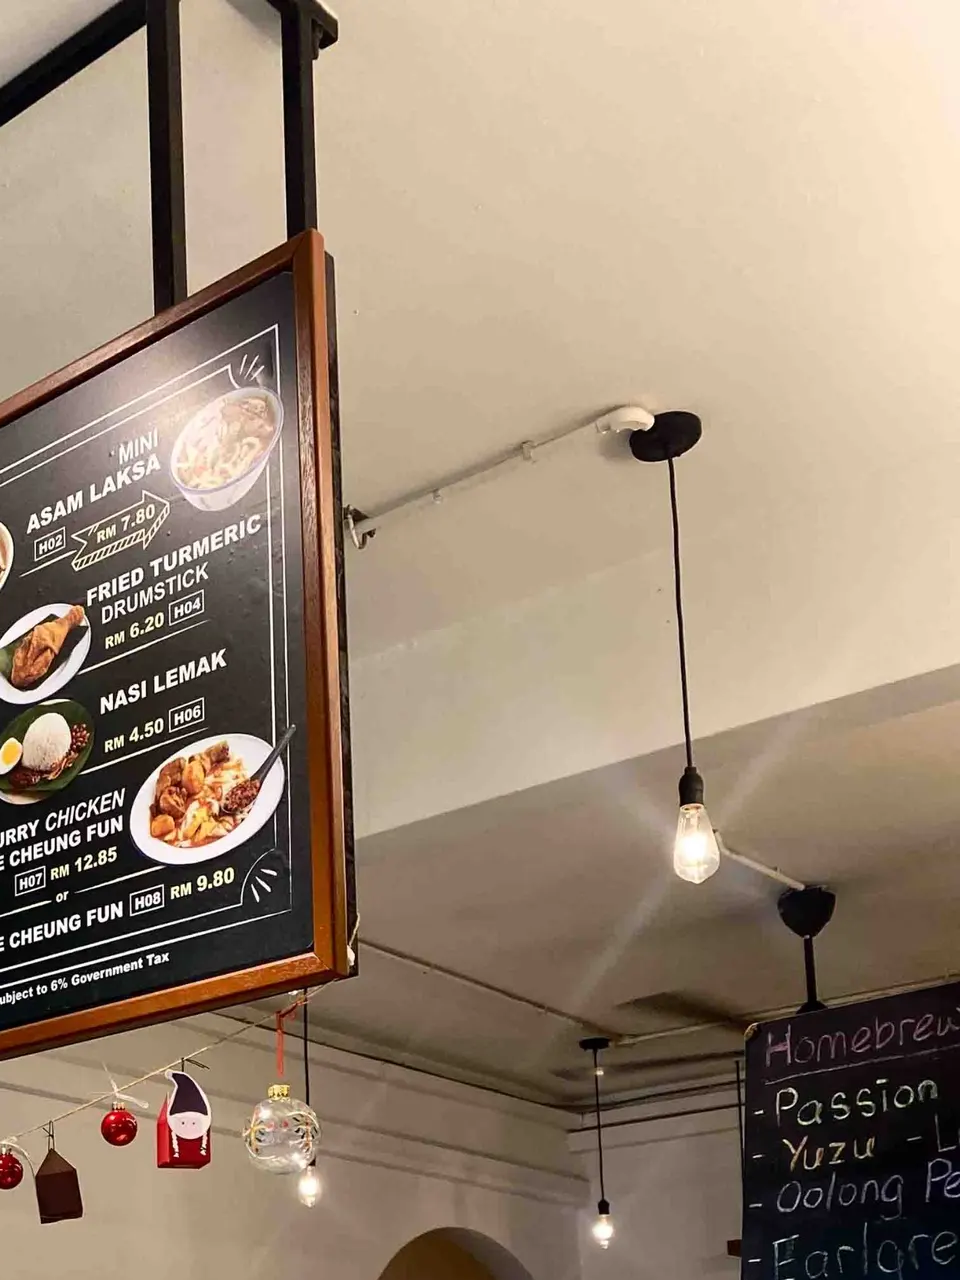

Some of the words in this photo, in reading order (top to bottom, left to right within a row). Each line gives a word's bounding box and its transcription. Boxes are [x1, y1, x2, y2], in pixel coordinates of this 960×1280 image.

[119, 427, 158, 465] MINI
[27, 491, 83, 534] ASAM
[90, 454, 161, 503] LAKSA
[121, 503, 155, 531] 7.80
[87, 567, 144, 607] FRIED
[150, 514, 262, 578] TURMERIC
[102, 562, 209, 625] DRUMSTICK
[130, 612, 164, 639] 6.20
[100, 680, 147, 715] NASI
[154, 649, 227, 693] LEMAK
[129, 718, 163, 742] 4.50
[45, 788, 125, 832] CHICKEN
[9, 831, 81, 871] CHEUNG
[87, 815, 124, 843] FUN
[74, 847, 118, 873] 12.85
[37, 985, 48, 994] to
[51, 978, 68, 992] 6%
[71, 958, 143, 986] Government
[146, 952, 169, 966] Tax
[783, 1135, 875, 1171] Yuzu
[776, 1171, 903, 1221] Oolong
[926, 1158, 960, 1202] Pe
